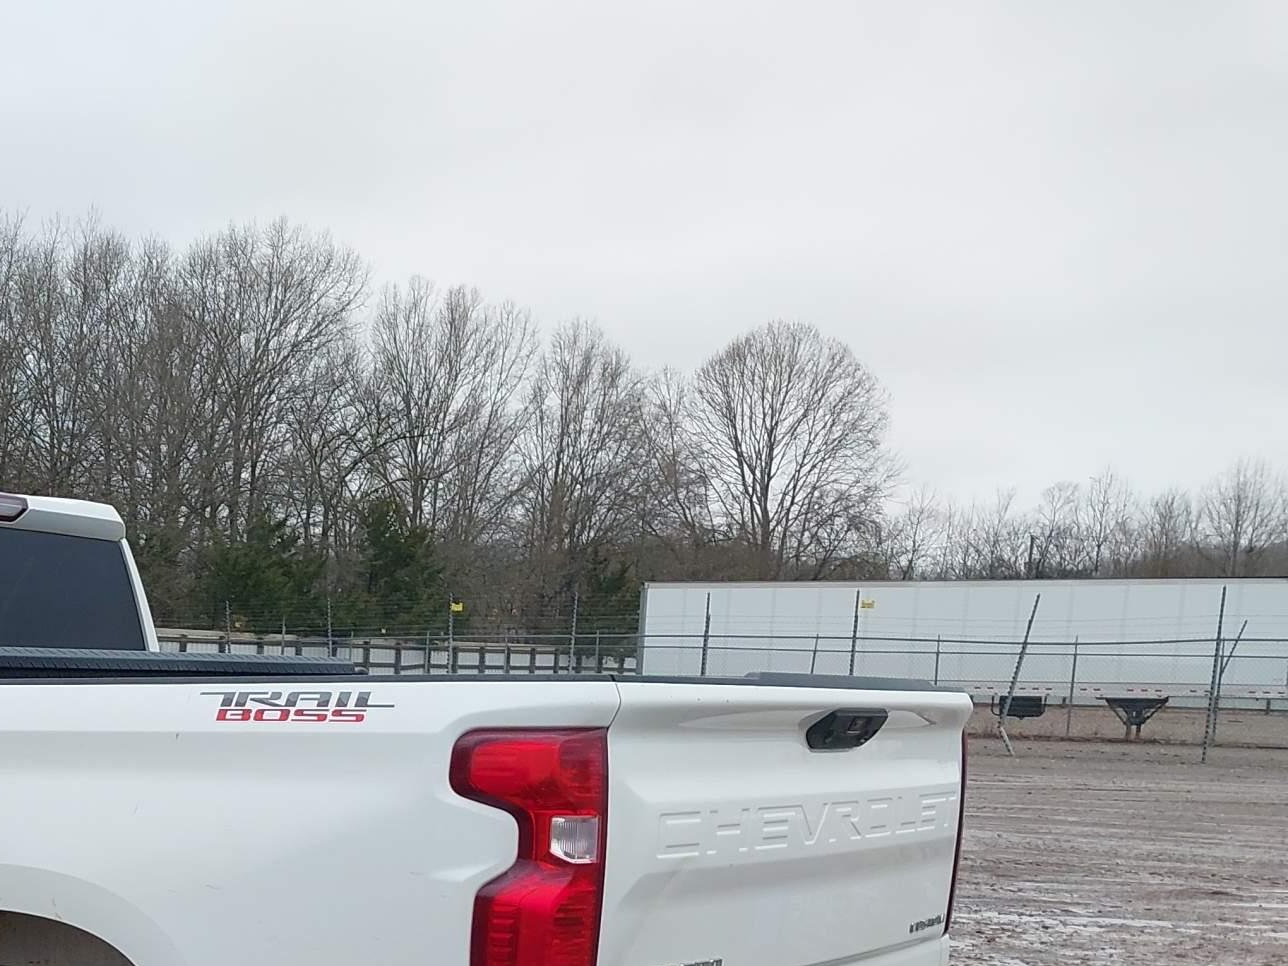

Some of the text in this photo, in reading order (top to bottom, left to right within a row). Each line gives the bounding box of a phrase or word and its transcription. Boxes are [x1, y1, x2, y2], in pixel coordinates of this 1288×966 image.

[200, 691, 395, 708] TRAIL
[216, 708, 367, 722] BOSS
[657, 791, 956, 858] CHEVROLET
